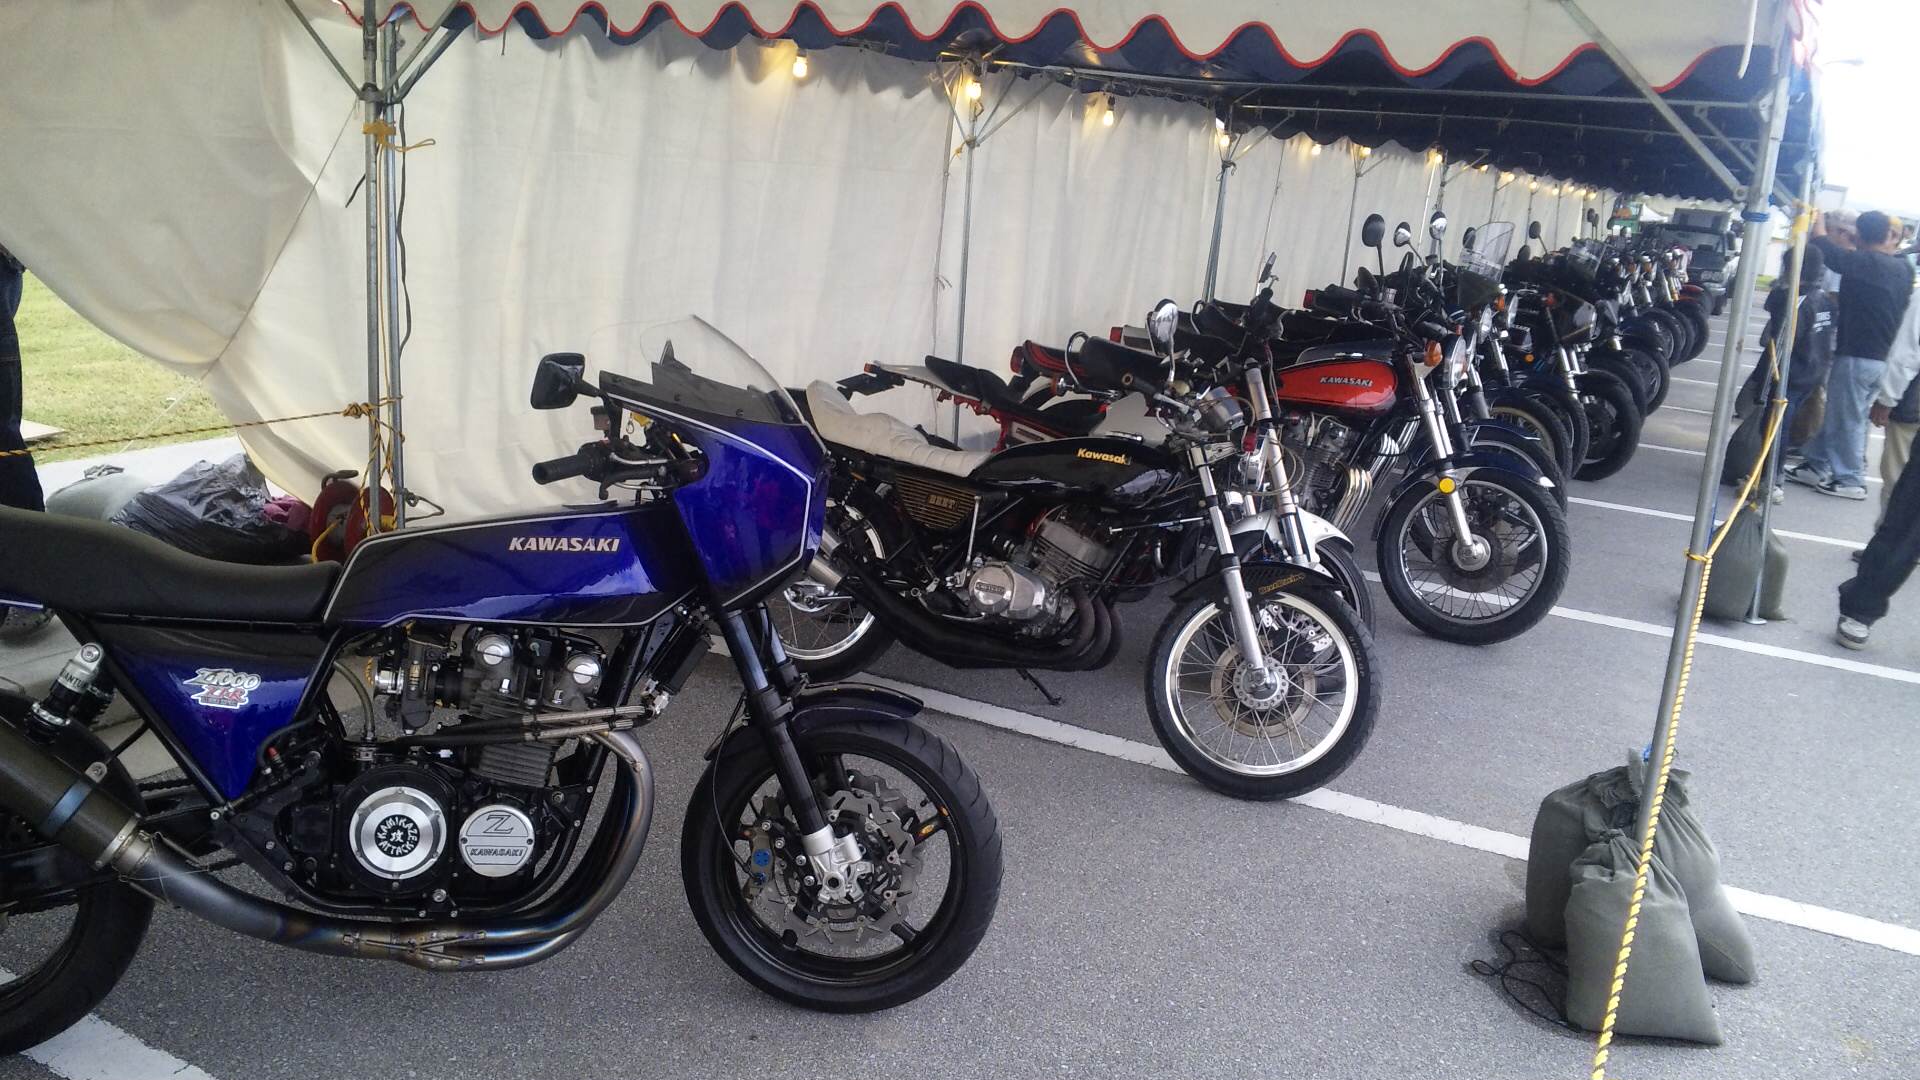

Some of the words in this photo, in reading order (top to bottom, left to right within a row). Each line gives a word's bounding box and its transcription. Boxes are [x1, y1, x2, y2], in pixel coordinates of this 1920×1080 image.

[1319, 377, 1373, 387] KAWASAKI
[509, 537, 620, 551] KAWASAKI
[377, 816, 418, 841] KAMIKAZE
[483, 814, 514, 834] Z
[378, 841, 415, 855] ATTACK
[470, 848, 524, 857] KAWASAKI
